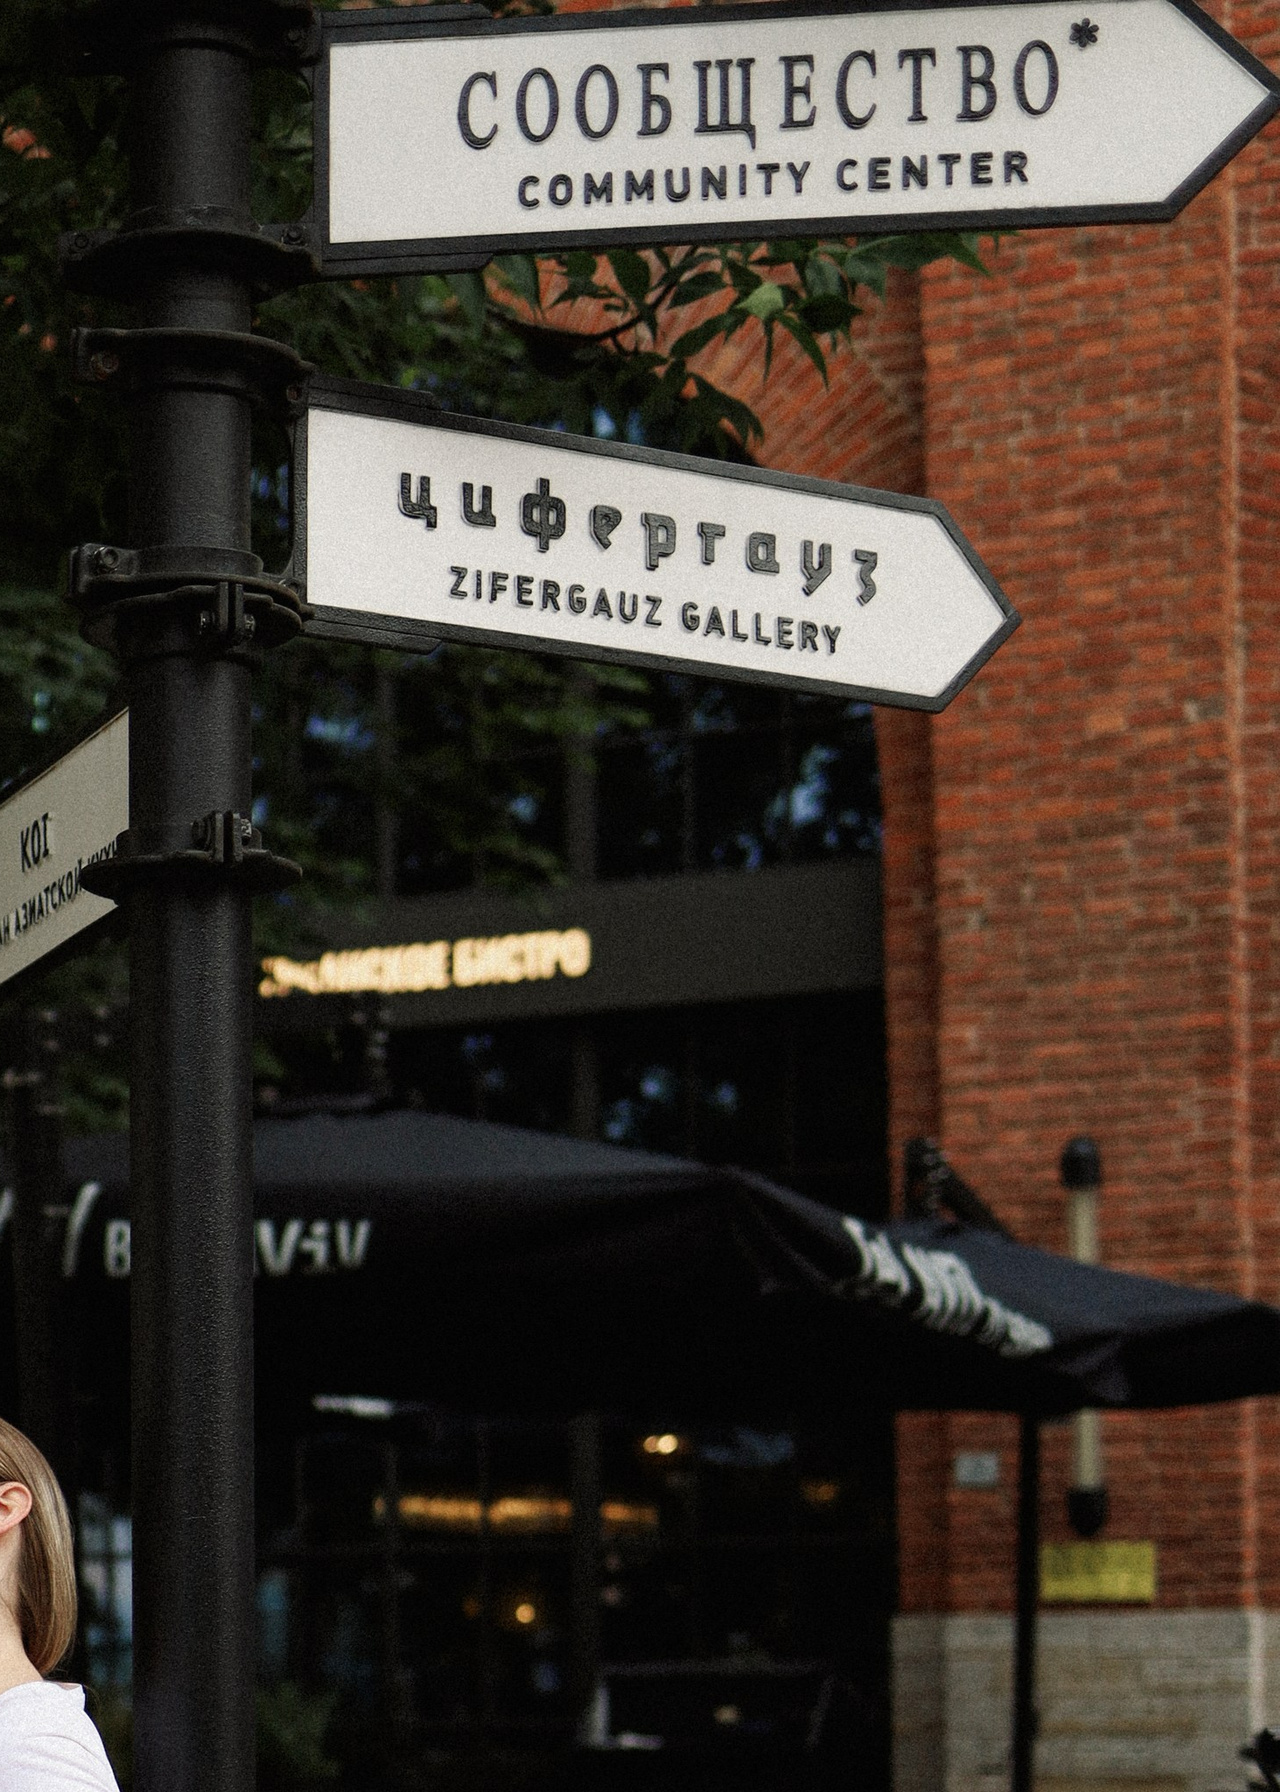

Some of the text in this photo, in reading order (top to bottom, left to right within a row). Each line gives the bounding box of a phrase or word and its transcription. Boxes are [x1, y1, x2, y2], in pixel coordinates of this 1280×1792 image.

[517, 150, 1030, 208] COMMUNITY CENTER
[448, 565, 843, 655] ZIFERGAUZ GALLERY
